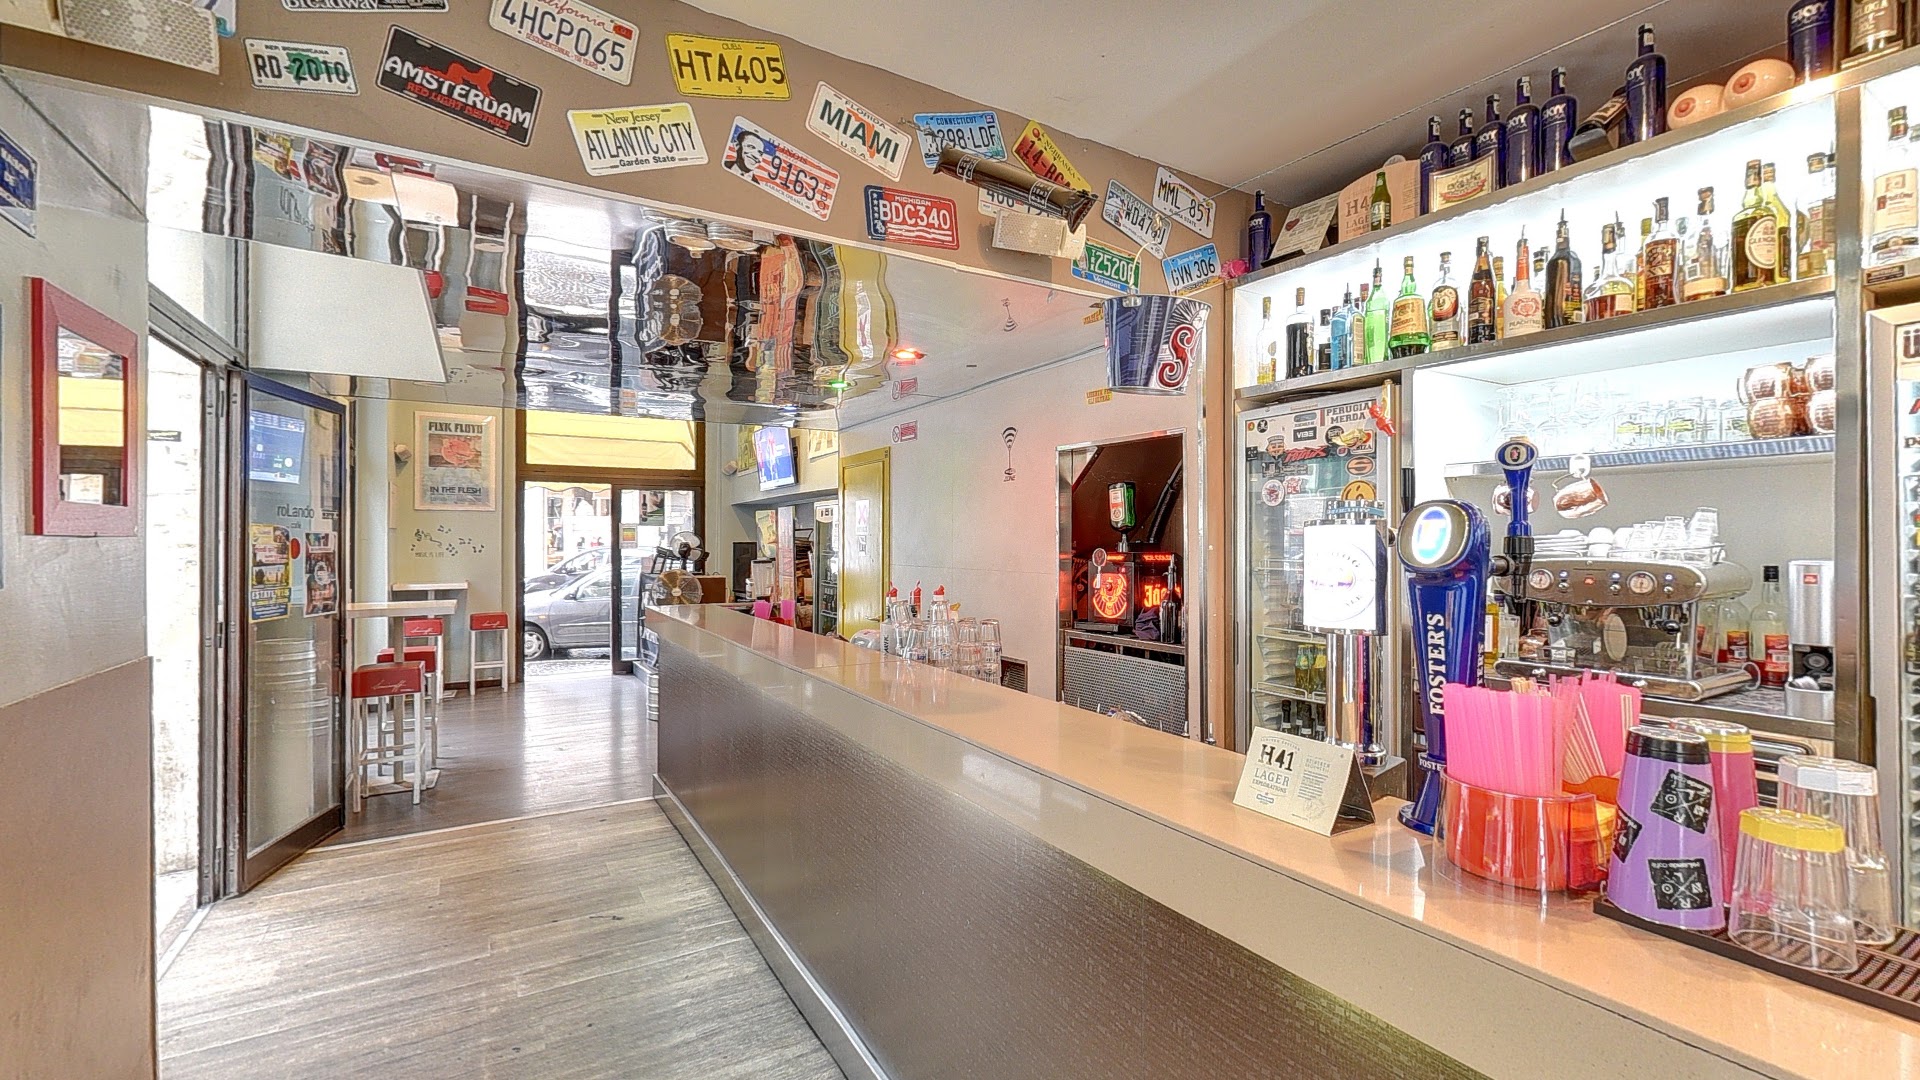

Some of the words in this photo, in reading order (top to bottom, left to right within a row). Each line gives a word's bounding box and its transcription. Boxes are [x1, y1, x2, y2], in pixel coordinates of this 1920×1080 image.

[501, 0, 626, 71] 4HCP065
[673, 48, 785, 84] HTA405
[385, 55, 531, 129] AMSTERDAM
[406, 82, 429, 97] RED
[430, 93, 463, 111] LIGHT
[464, 105, 511, 130] DISTRICT
[604, 113, 629, 125] New
[631, 111, 661, 125] Jersey
[844, 100, 886, 129] FLORIDA
[935, 116, 978, 126] CONNECTICUT
[585, 125, 660, 160] ATLANTIC
[659, 122, 696, 153] CITY
[819, 98, 899, 163] MIAMI
[619, 158, 650, 168] Garden
[652, 156, 676, 164] State
[1044, 139, 1076, 179] NEBRASKA
[768, 155, 819, 201] 9163
[879, 199, 950, 229] BDC340
[894, 195, 931, 206] MICHIGAN
[1158, 177, 1181, 210] MML
[1189, 198, 1211, 228] 851
[1345, 215, 1371, 229] LAGE
[1093, 274, 1121, 289] Vermont
[1171, 263, 1194, 287] GVN
[1193, 256, 1216, 279] 306
[1325, 402, 1371, 417] PERUGIA
[1330, 412, 1366, 425] MERDA
[454, 423, 483, 434] FLOYD
[441, 486, 456, 494] THE
[457, 486, 482, 495] FLESH
[277, 503, 316, 519] roLando
[1426, 612, 1446, 717] FOSTER'S
[1258, 743, 1295, 772] H41
[1251, 778, 1288, 794] EXPLORATIONS
[1254, 767, 1291, 788] LAGER
